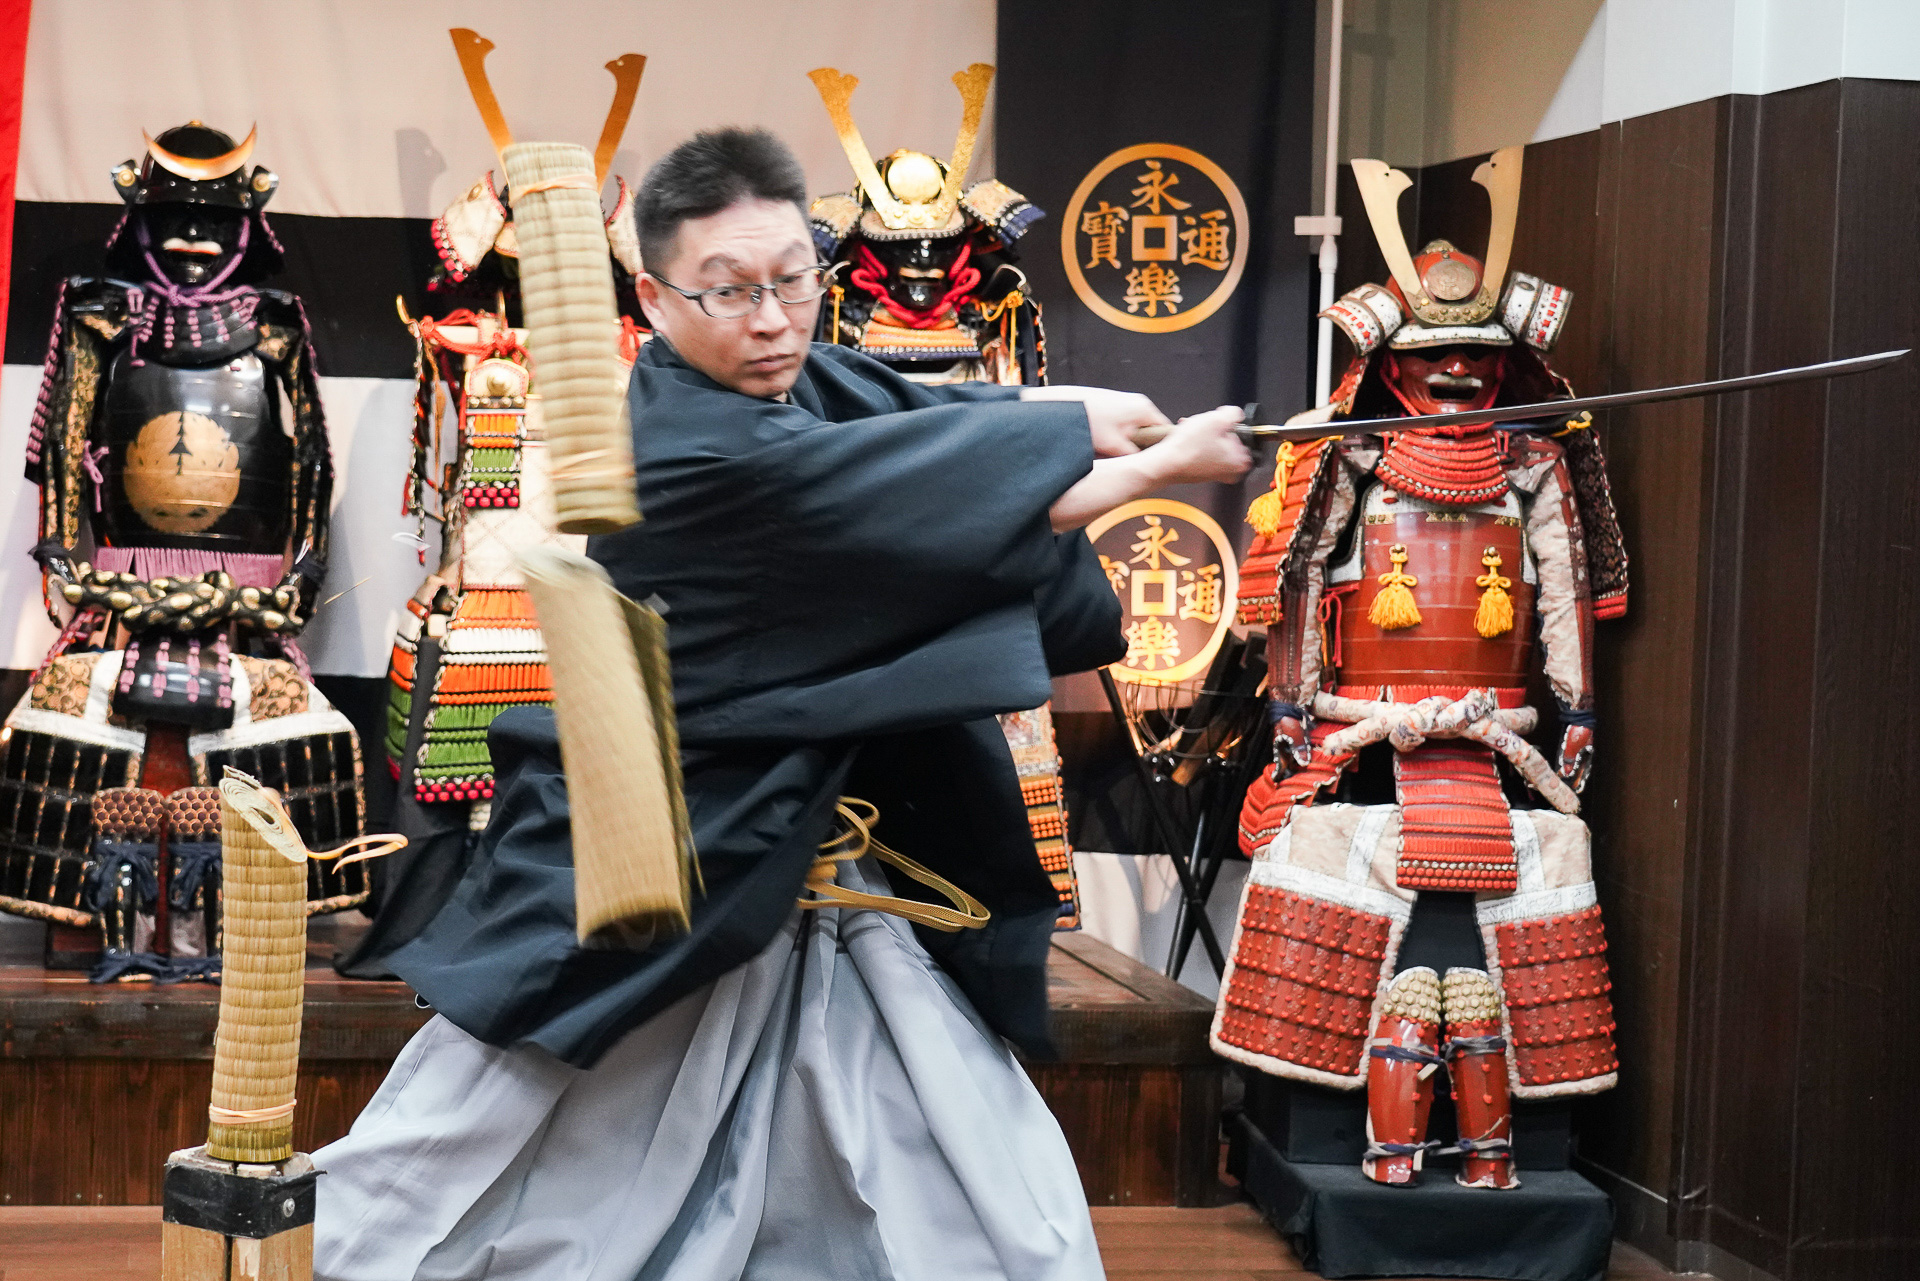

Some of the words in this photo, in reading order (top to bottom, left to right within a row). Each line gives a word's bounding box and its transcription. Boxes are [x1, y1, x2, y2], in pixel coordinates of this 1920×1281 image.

[1130, 160, 1191, 214] 永
[1179, 209, 1230, 270] 通
[1122, 262, 1184, 317] 樂
[1129, 515, 1191, 570] 永
[1177, 563, 1222, 624] 通
[1125, 615, 1181, 671] 樂
